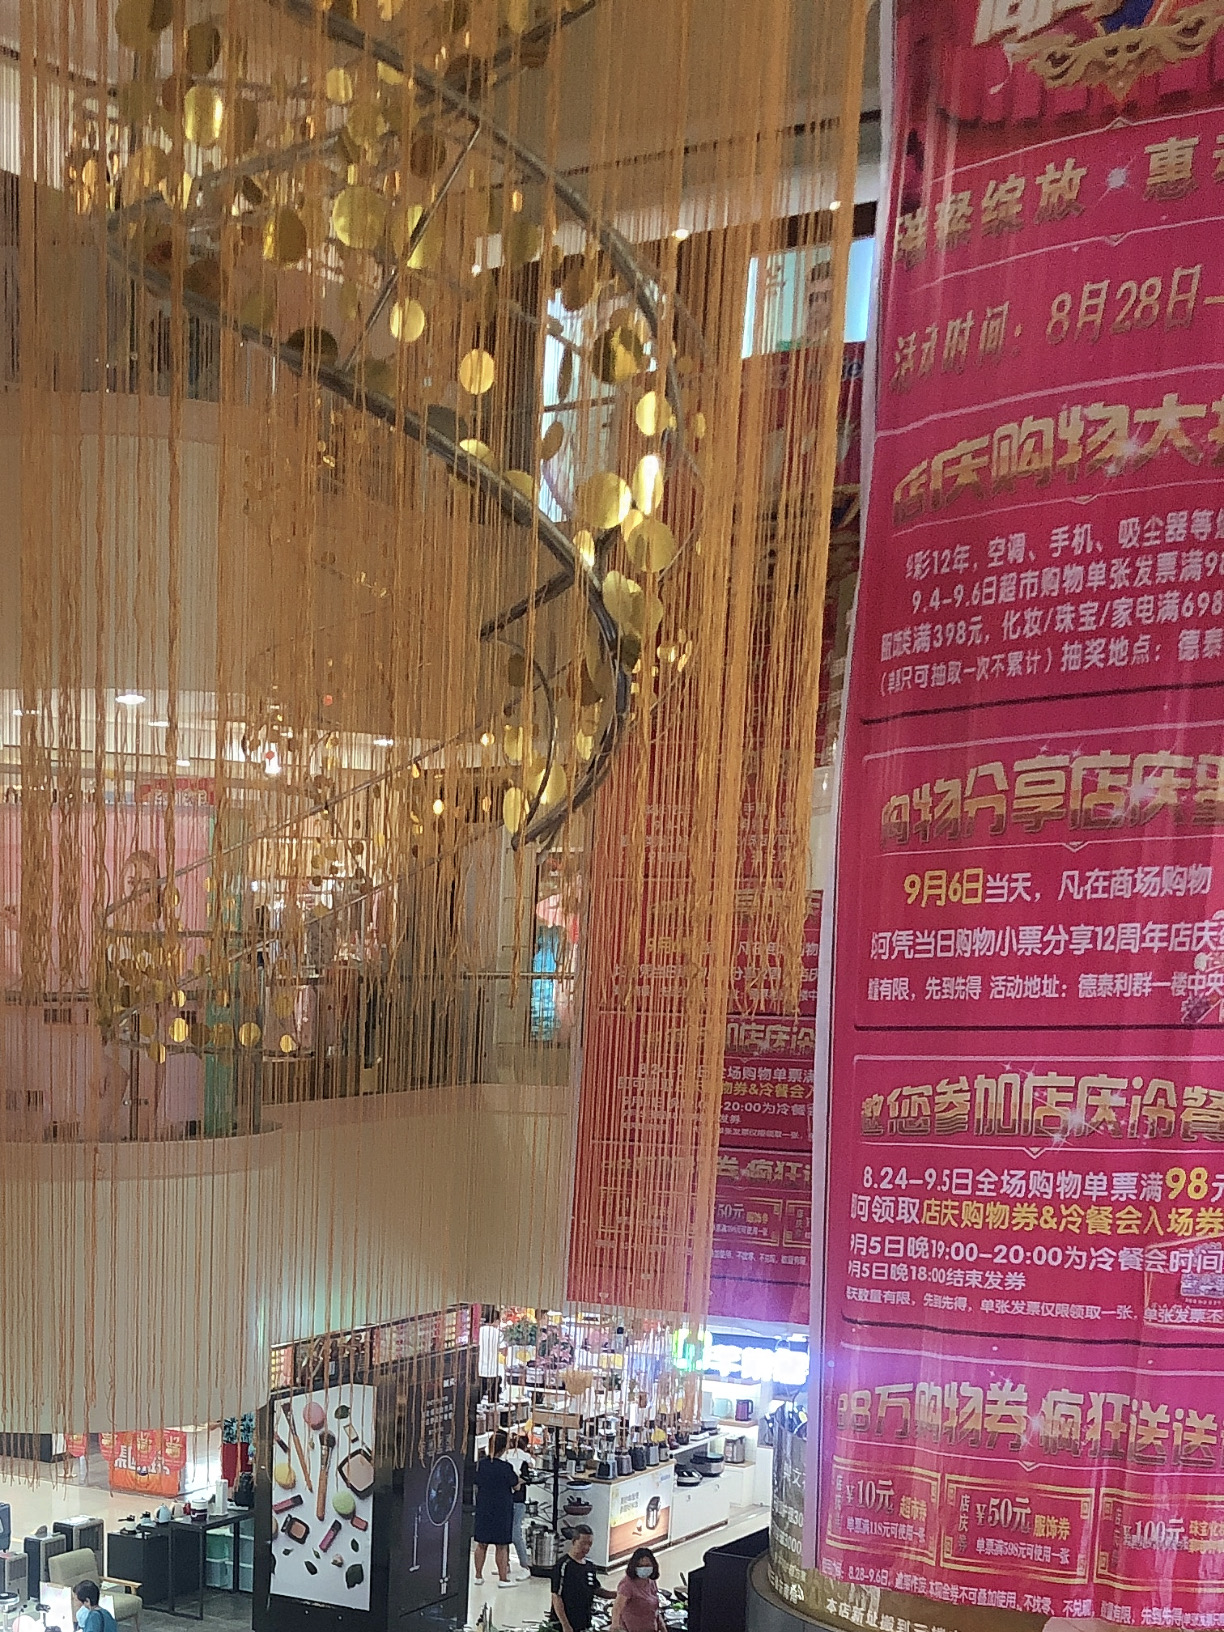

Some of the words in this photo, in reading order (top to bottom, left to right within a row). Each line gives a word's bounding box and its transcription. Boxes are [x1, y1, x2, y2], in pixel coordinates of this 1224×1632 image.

[892, 392, 1224, 524] 店庆购物大
